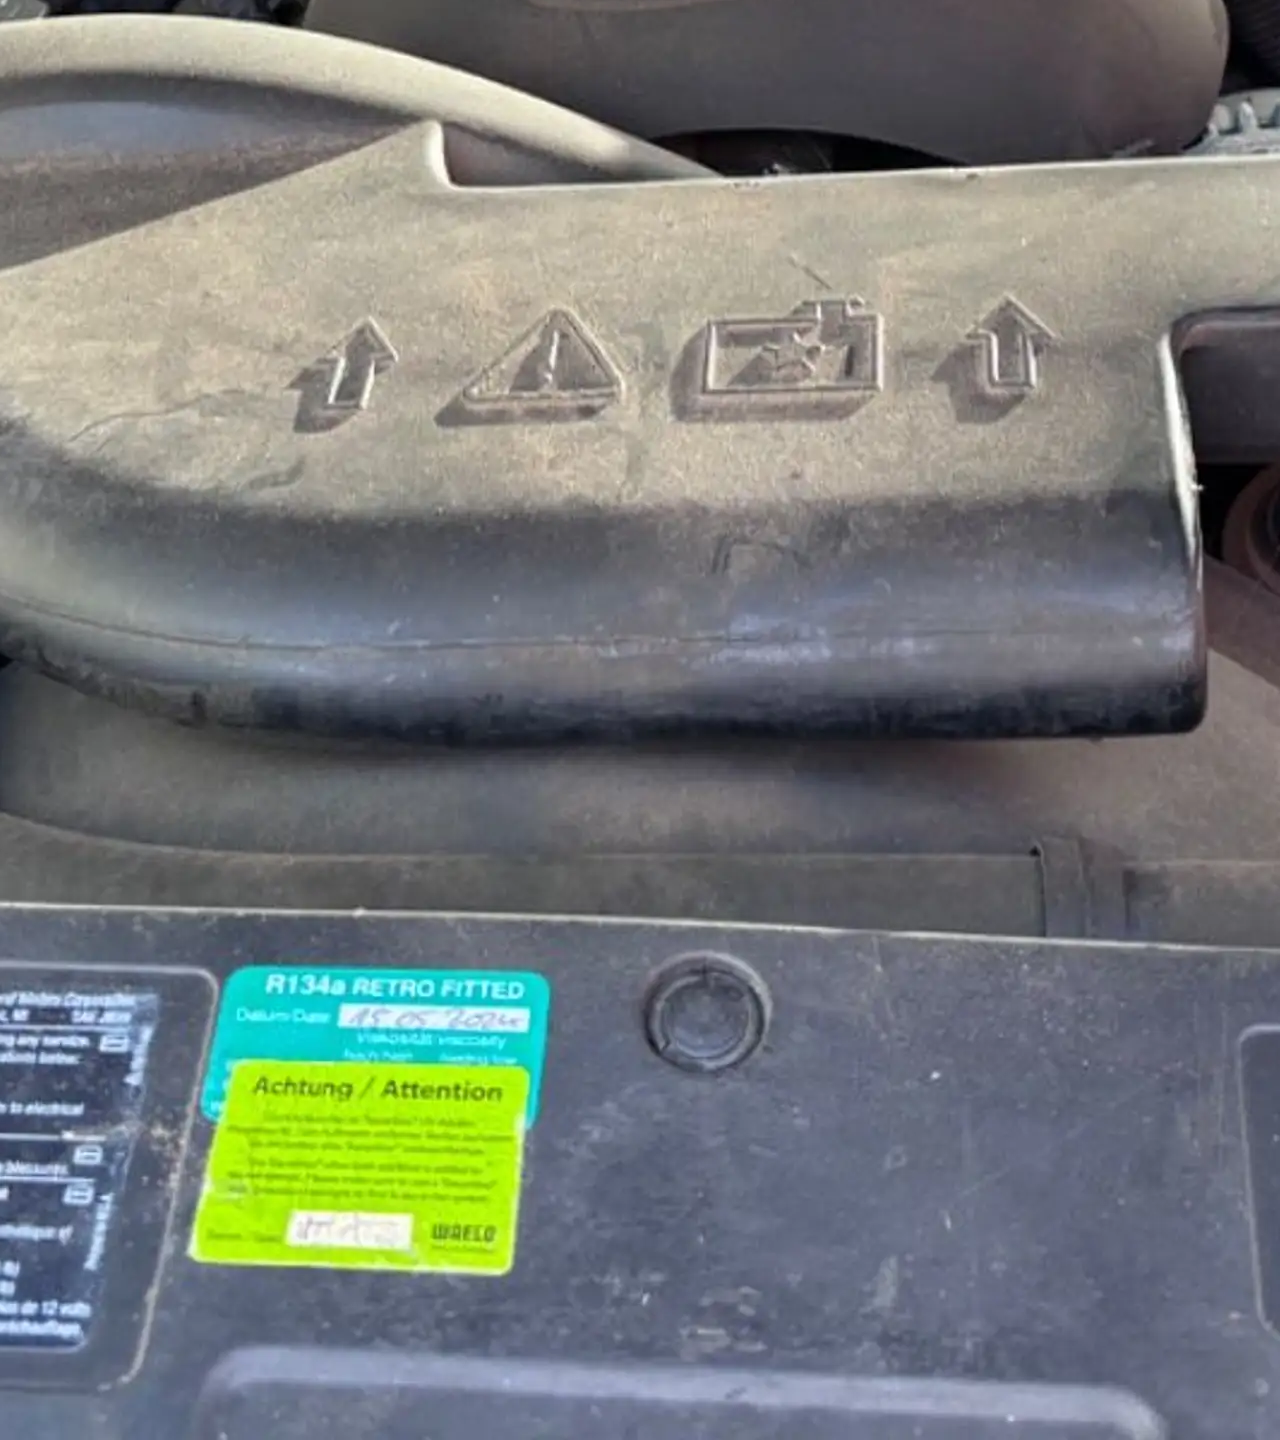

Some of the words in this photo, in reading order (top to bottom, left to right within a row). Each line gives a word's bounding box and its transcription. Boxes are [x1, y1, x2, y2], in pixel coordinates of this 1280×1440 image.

[266, 974, 346, 995] R134a
[353, 978, 434, 998] RETRO
[440, 980, 526, 999] FITTED
[253, 1076, 354, 1102] Achtung
[381, 1079, 503, 1102] Attention
